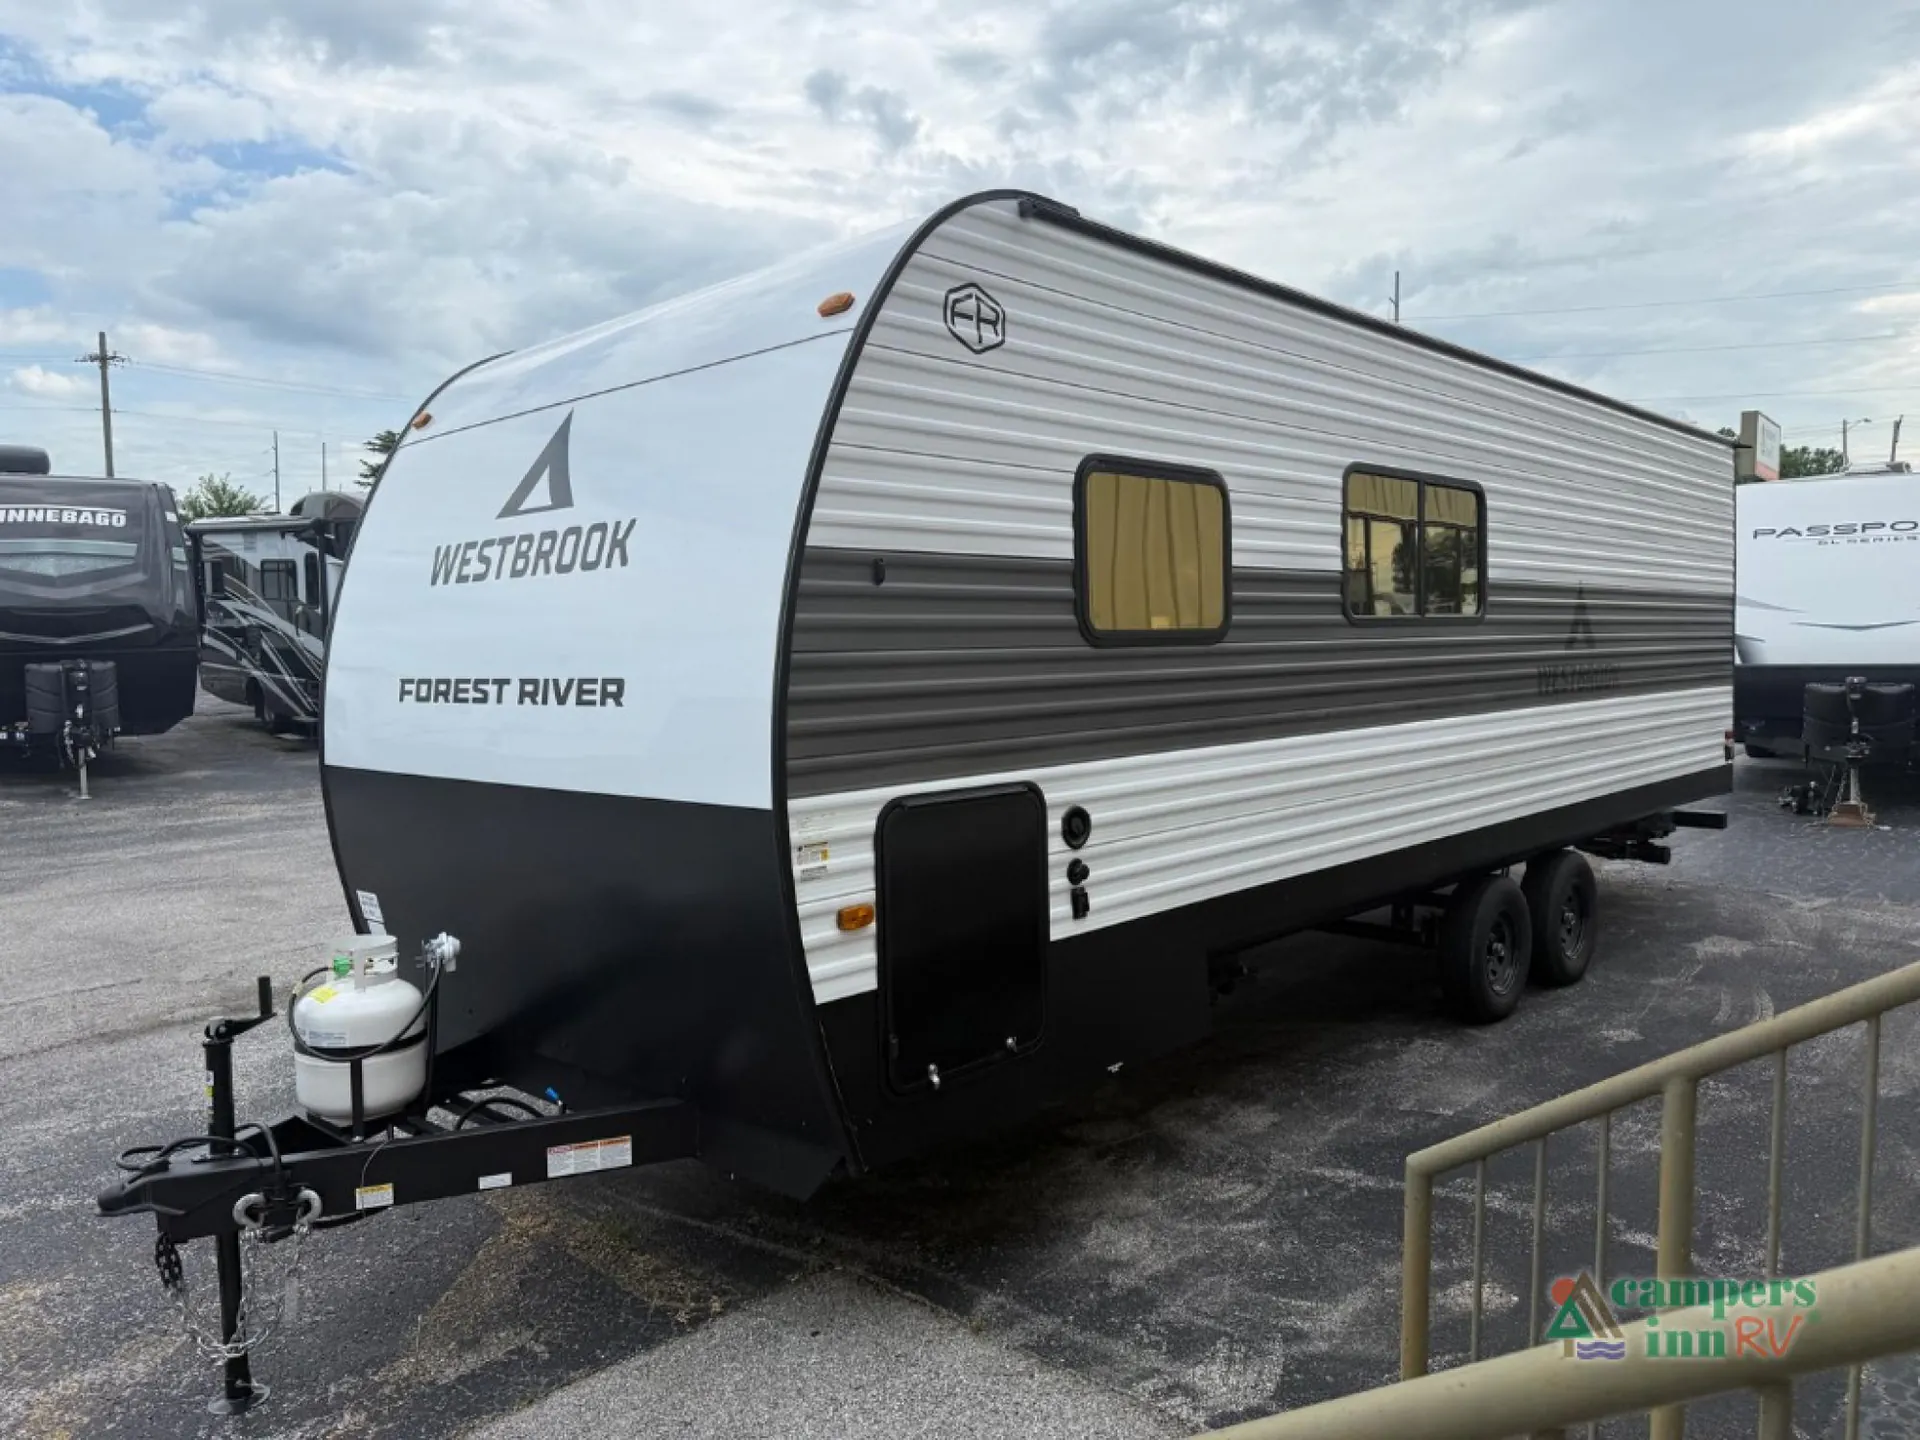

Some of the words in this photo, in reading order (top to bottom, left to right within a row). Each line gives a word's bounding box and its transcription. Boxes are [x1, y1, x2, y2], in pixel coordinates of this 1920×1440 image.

[1753, 520, 1919, 539] PASSPO
[431, 518, 637, 586] WESTBROOK
[399, 678, 511, 704] FOREST
[517, 678, 625, 707] RIVER
